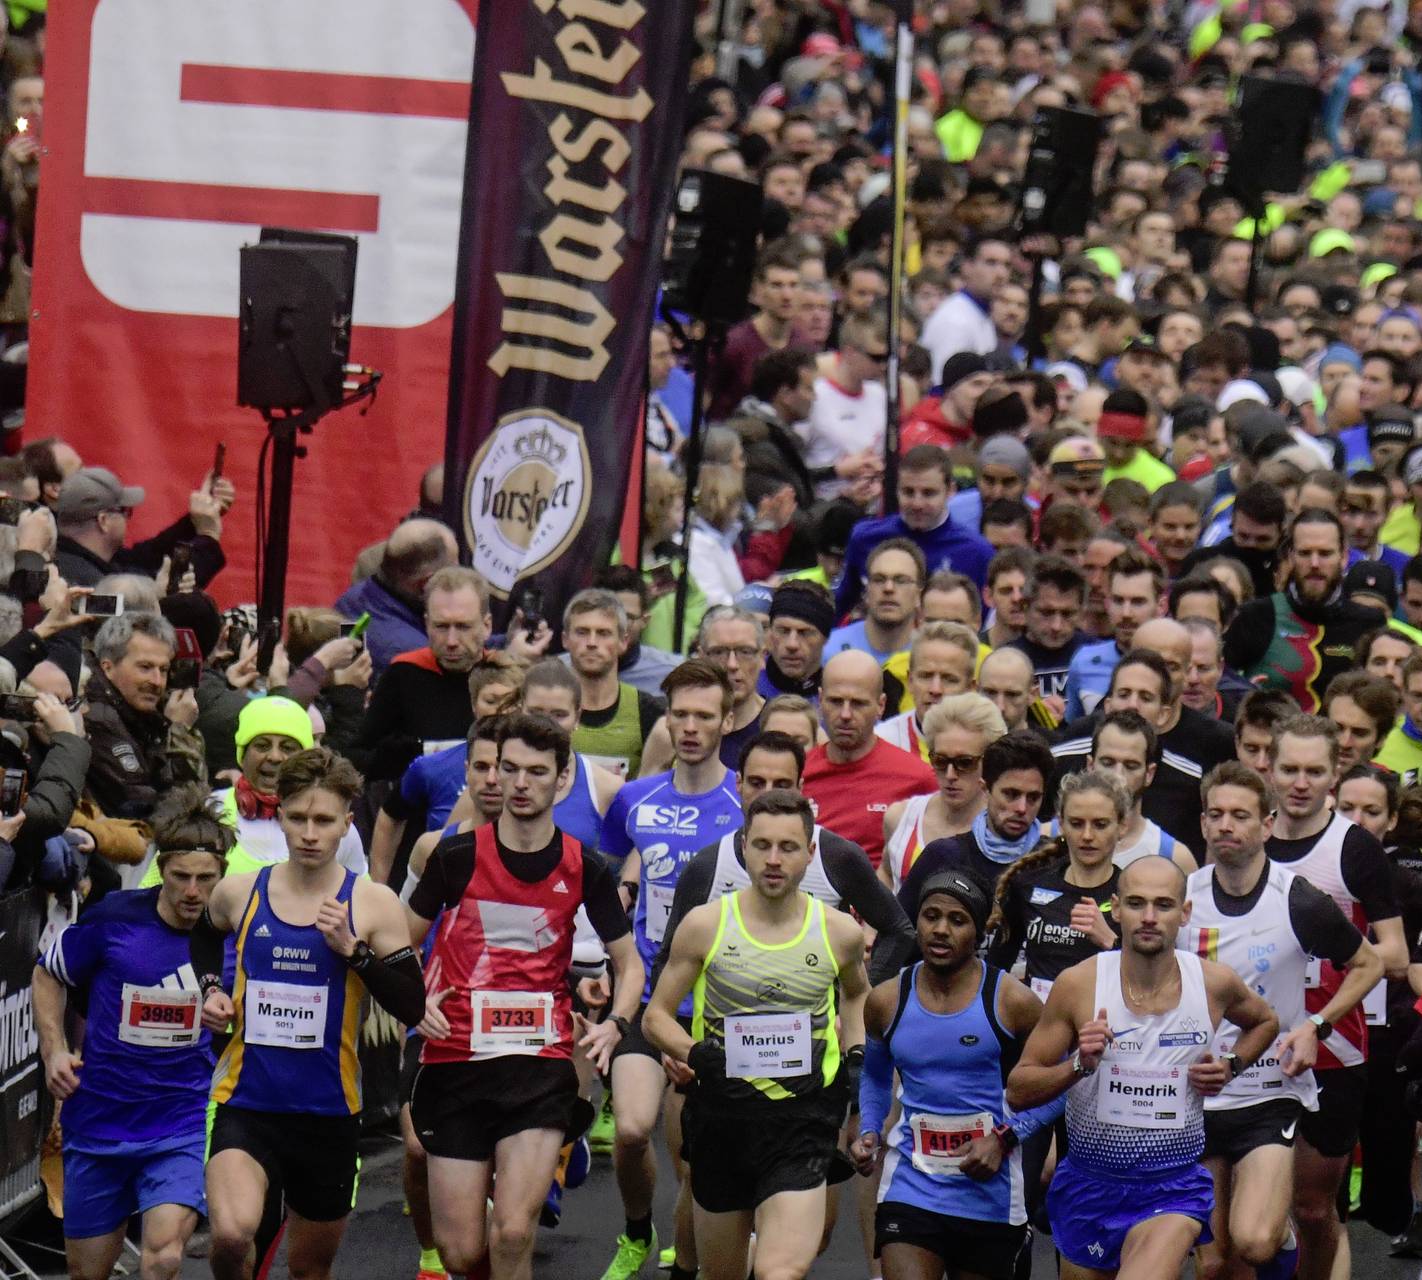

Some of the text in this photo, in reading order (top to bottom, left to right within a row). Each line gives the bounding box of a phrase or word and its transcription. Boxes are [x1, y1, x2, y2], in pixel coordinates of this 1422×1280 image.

[1032, 890, 1055, 903] SAP
[1043, 935, 1075, 946] SPORTS
[283, 947, 310, 960] RWW
[141, 1006, 185, 1023] 3985
[258, 1003, 314, 1020] Marvin
[492, 1010, 535, 1026] 3733
[742, 1034, 795, 1046] Marius
[1109, 1081, 1178, 1097] Hendrik
[1132, 1100, 1154, 1108] 5004
